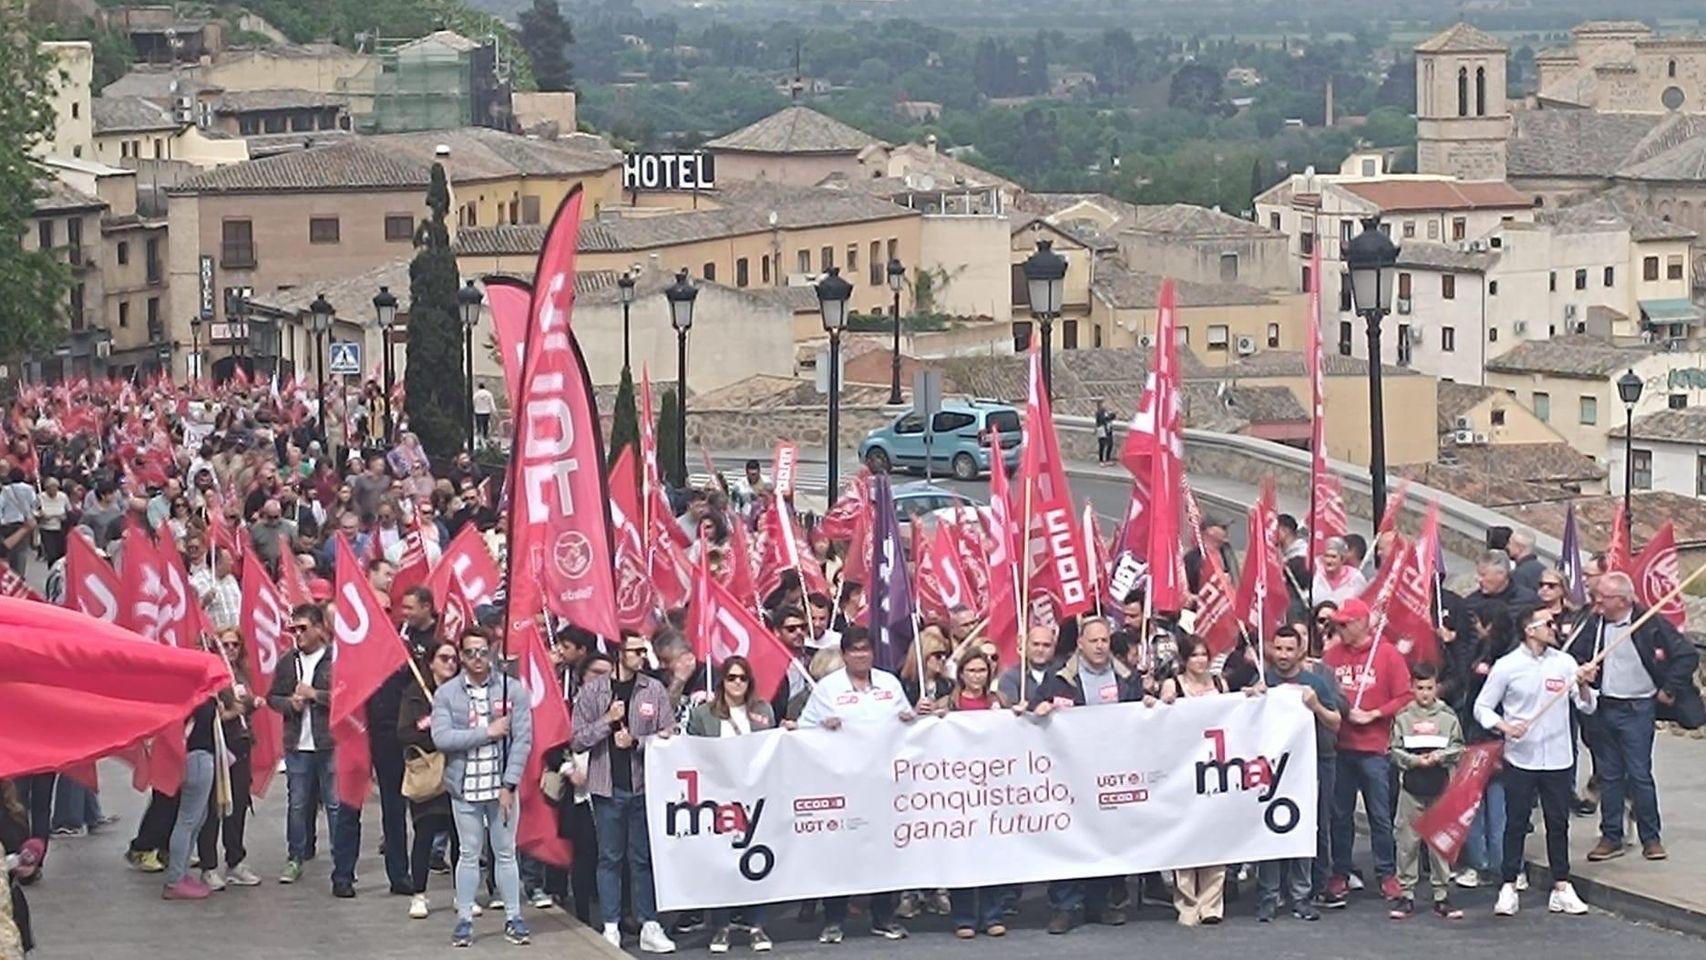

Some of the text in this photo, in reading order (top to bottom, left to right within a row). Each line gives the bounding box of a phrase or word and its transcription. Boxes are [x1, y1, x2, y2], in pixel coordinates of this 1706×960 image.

[624, 155, 714, 188] HOTEL
[202, 258, 212, 310] HOTEL
[1046, 508, 1085, 604] CCOO
[893, 750, 1051, 786] Proteger lo
[1097, 774, 1126, 788] UGT
[796, 799, 830, 810] CCOO
[893, 778, 1076, 815] conquistado,
[1101, 793, 1133, 803] CCOO
[794, 819, 824, 834] UGT
[893, 820, 977, 848] ganar
[989, 811, 1071, 836] futuro
